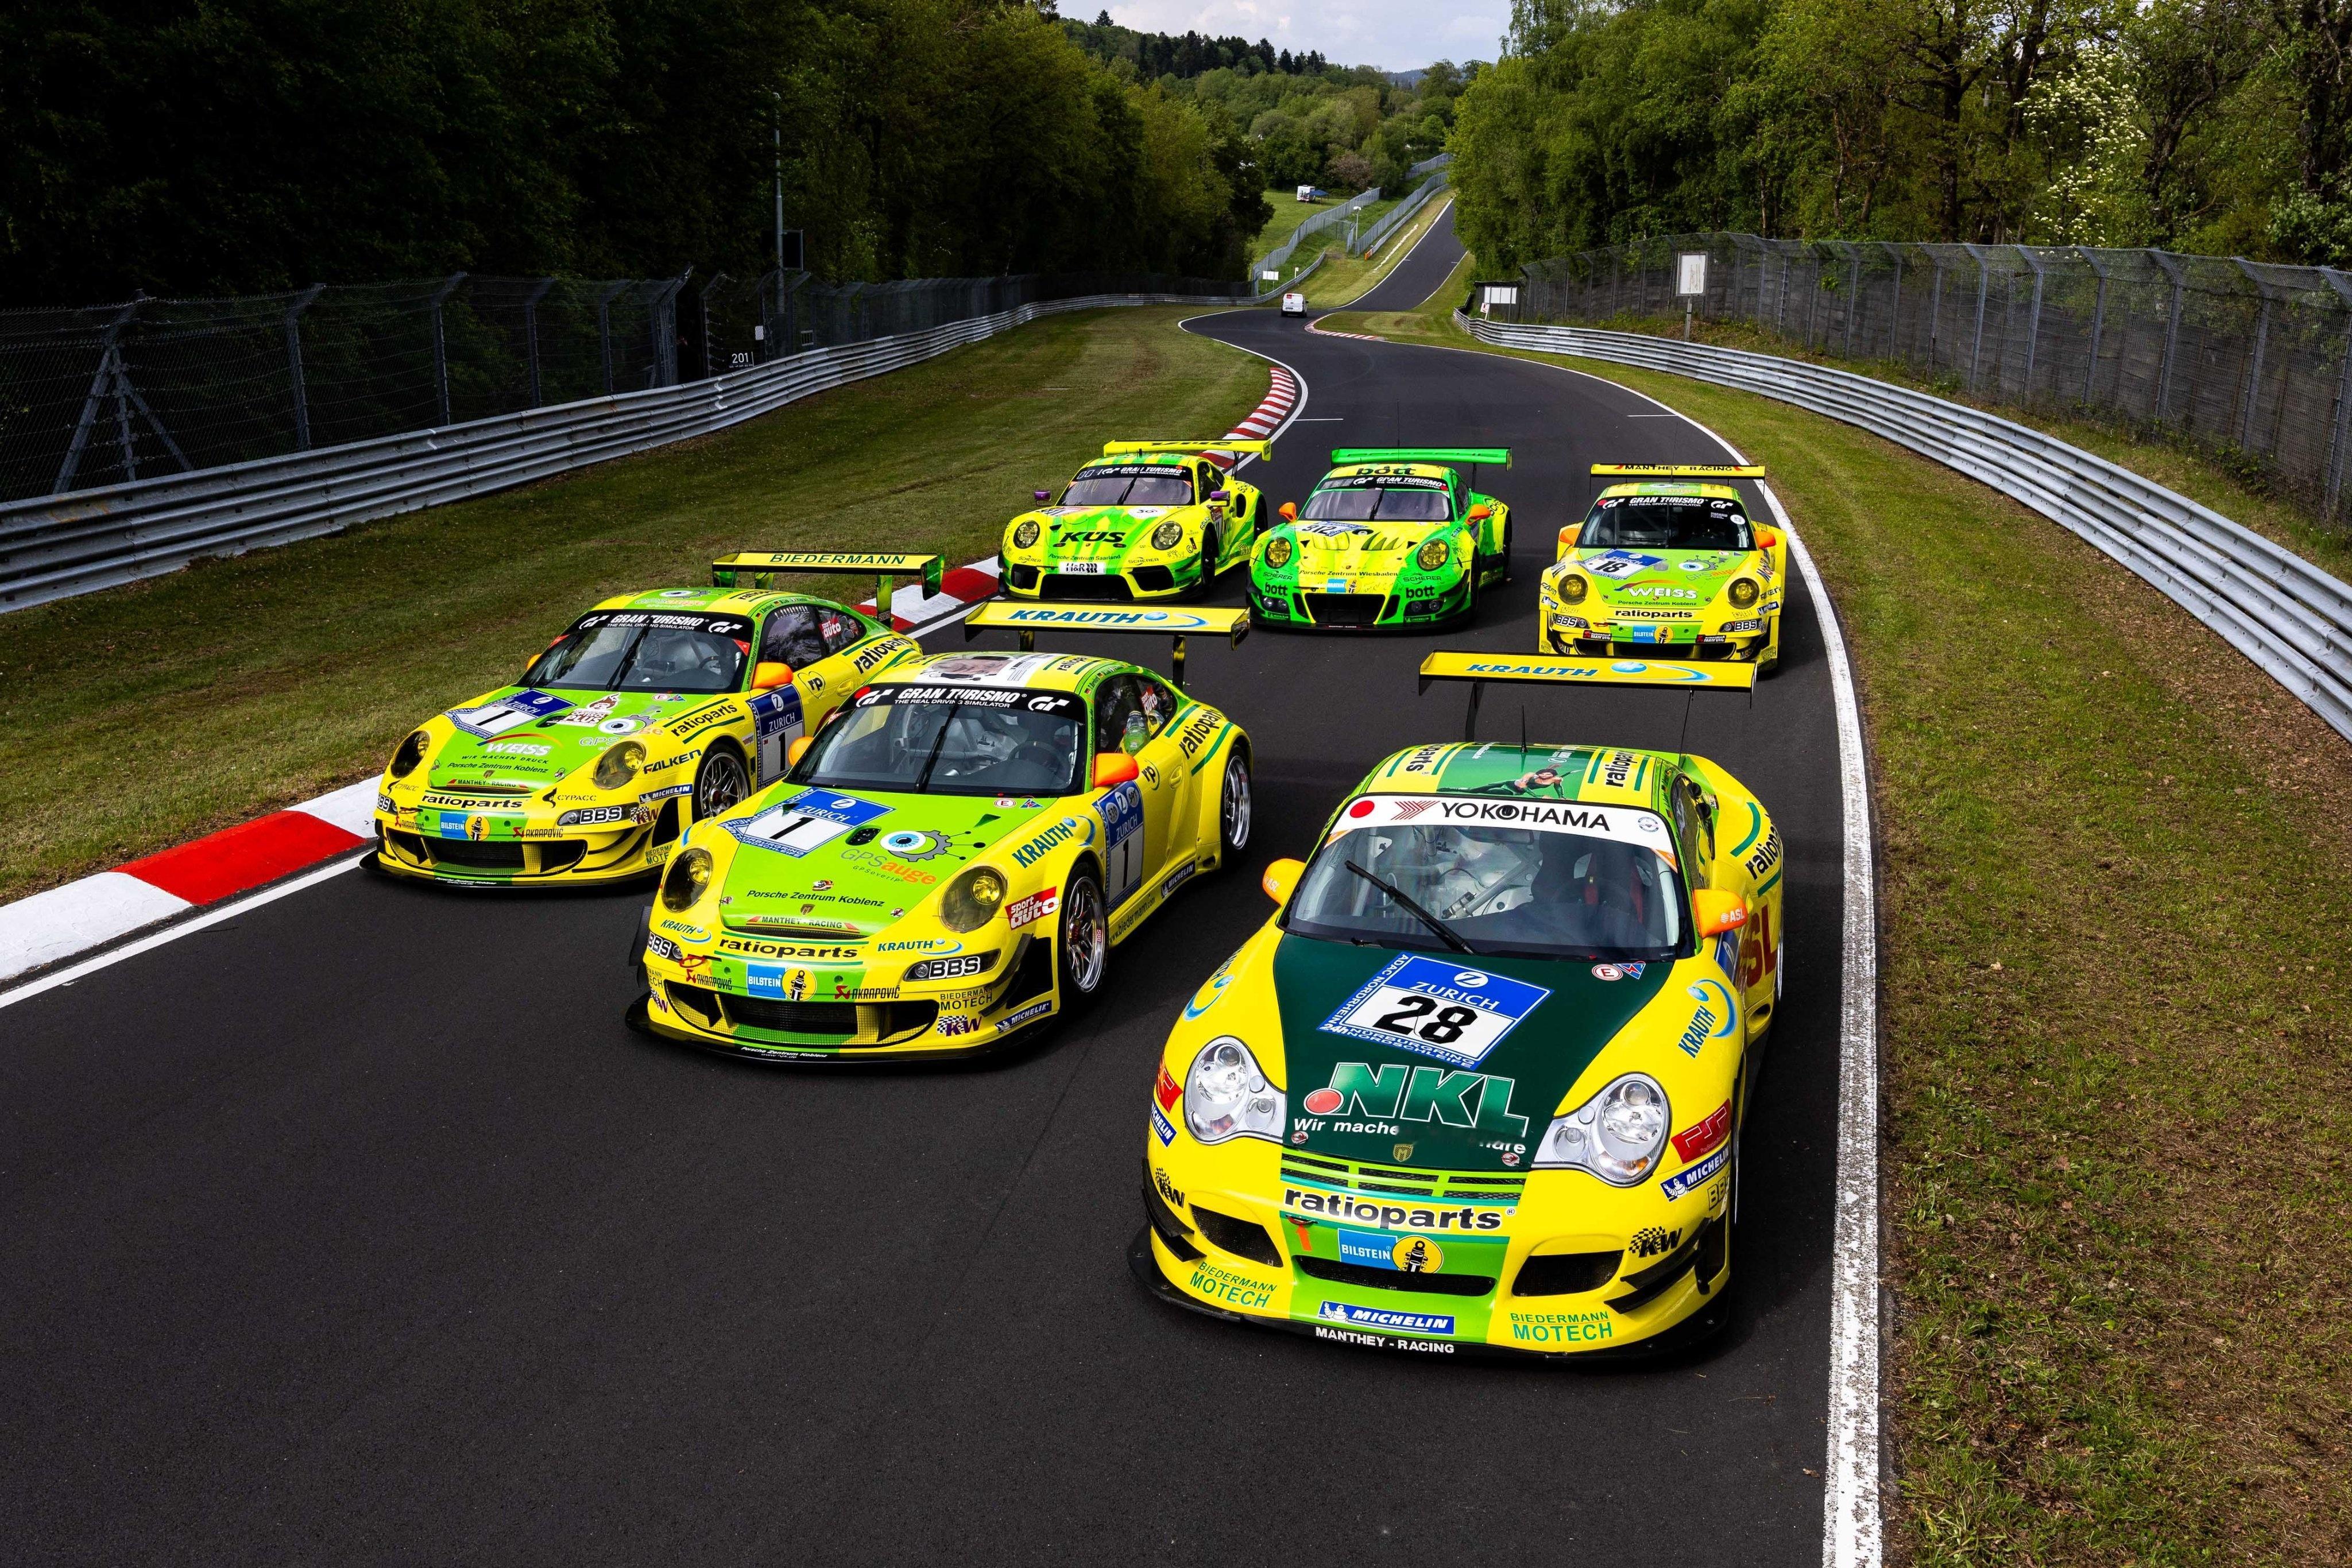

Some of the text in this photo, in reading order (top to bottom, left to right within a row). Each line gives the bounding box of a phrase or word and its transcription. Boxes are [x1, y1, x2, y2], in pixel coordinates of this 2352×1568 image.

[731, 352, 749, 363] 201
[1356, 467, 1417, 475] bott
[1405, 477, 1443, 487] TURISMO
[1659, 497, 1704, 505] TURISMO
[769, 553, 906, 565] BIEDERMANN
[1594, 560, 1628, 573] 18
[1610, 556, 1643, 565] ZURICH
[1263, 571, 1293, 580] SCHERER
[1403, 575, 1442, 583] SCHERER
[1264, 582, 1288, 596] bott
[1406, 585, 1436, 599] bott
[1628, 587, 1698, 599] WEISS
[610, 614, 704, 627] GRAN TURISMO
[1008, 610, 1144, 624] KRAUTH
[1556, 615, 1577, 626] BBS
[1615, 609, 1693, 619] ratioparts
[821, 621, 831, 629] sport
[823, 622, 842, 638] auto
[1734, 621, 1757, 631] BBS
[1465, 663, 1599, 677] KRAUTH
[807, 676, 823, 692] rp
[898, 688, 1020, 703] GRAN TURISMO
[508, 700, 541, 714] ZURICH
[964, 700, 1011, 708] SIMULATOR
[475, 710, 516, 726] 1
[563, 715, 602, 723] PLUS
[670, 702, 738, 737] ratioparts
[748, 701, 760, 727] ADAC
[768, 712, 795, 733] ZURICH
[485, 741, 553, 756] WEISS
[778, 731, 786, 772] 1
[479, 762, 511, 771] Zentrum
[514, 765, 549, 773] Koblenz
[643, 749, 702, 775] FALKEN
[652, 785, 691, 799] MICHELIN
[421, 795, 524, 808] ratioparts
[580, 806, 622, 824] BBS
[797, 805, 850, 822] ZURICH
[1440, 801, 1611, 832] YOKOHAMA
[440, 821, 465, 831] BILSTEIN
[769, 816, 817, 840] 1
[1116, 816, 1138, 841] ZURICH
[1011, 822, 1074, 869] KRAUTH
[841, 848, 937, 885] GPSauge
[1123, 838, 1129, 889] 1
[1168, 864, 1194, 889] MICHELIN
[746, 890, 885, 907] Porsche Zentrum Koblenz
[1011, 895, 1035, 914] sport
[1011, 896, 1060, 929] auto
[1730, 908, 1745, 923] ASL
[660, 919, 697, 935] KRAUTH
[761, 916, 843, 928] MANTHEY RACING
[648, 933, 671, 958] BBS
[718, 938, 858, 959] ratioparts
[877, 939, 934, 953] KRAUTH
[929, 957, 980, 979] BBS
[747, 976, 782, 988] BILSTEIN
[1326, 954, 1409, 1025] ADAC NORDRHEIN
[939, 987, 992, 1000] BIEDERMANN
[1409, 981, 1502, 1011] ZURICH
[939, 995, 993, 1011] MOTECH
[1009, 1002, 1050, 1025] MICHELIN
[1372, 994, 1479, 1045] 28
[945, 1016, 982, 1036] KW
[1318, 1023, 1349, 1035] 24h
[1678, 1005, 1717, 1059] KRAUTH
[1347, 1030, 1474, 1070] NORDSCHLEIFE
[1326, 1061, 1531, 1139] NKL
[1293, 1117, 1326, 1132] Wir
[1681, 1106, 1727, 1148] PSP
[1685, 1145, 1729, 1186] MICHELIN
[1283, 1187, 1502, 1230] ratioparts
[1638, 1227, 1683, 1258] KW
[1341, 1244, 1391, 1261] BILSTEIN
[1198, 1261, 1278, 1292] BIEDERMANN
[1189, 1271, 1271, 1308] MOTECH
[1351, 1309, 1449, 1330] MICHELIN
[1510, 1311, 1609, 1323] BIEDERMANN
[1512, 1321, 1614, 1342] MOTECH
[1315, 1326, 1455, 1354] MANTHEY RACING
